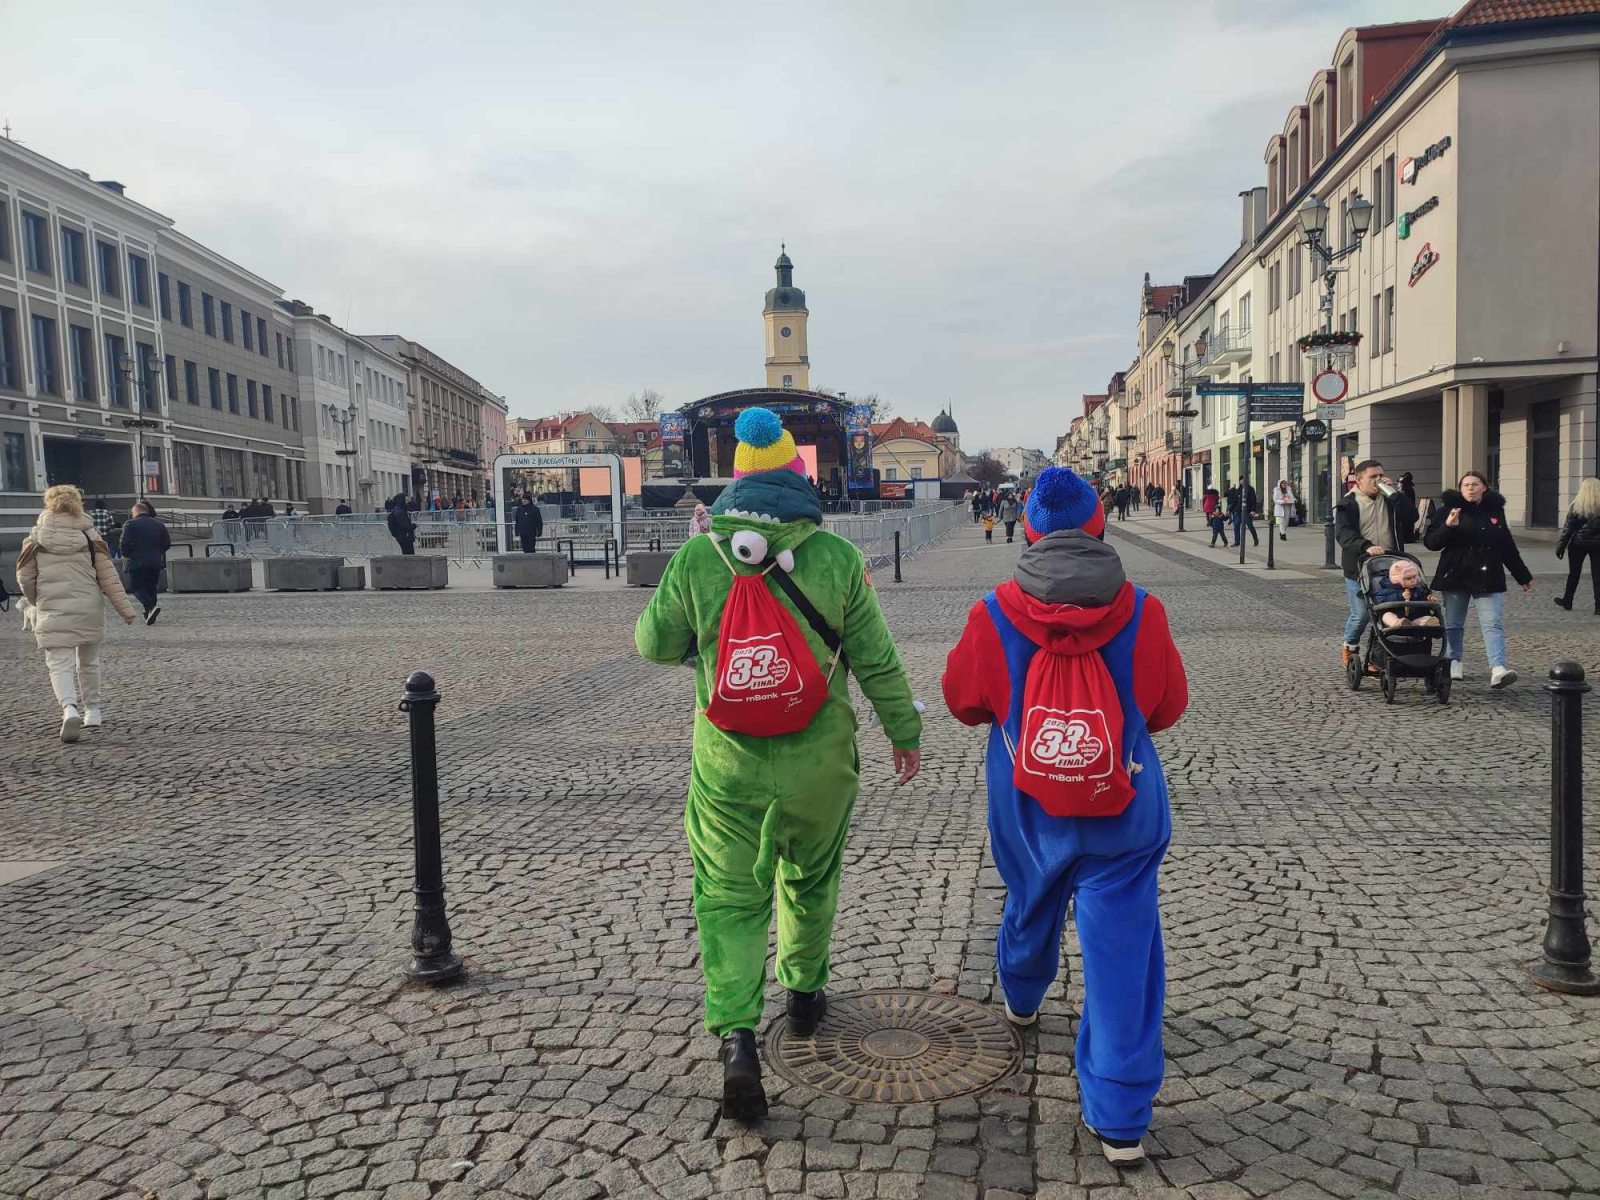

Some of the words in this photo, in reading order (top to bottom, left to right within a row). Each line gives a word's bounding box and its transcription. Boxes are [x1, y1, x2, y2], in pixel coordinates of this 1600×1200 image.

[730, 648, 775, 686] 33
[746, 692, 778, 702] mBank
[1035, 725, 1085, 758] 33
[1048, 773, 1085, 782] mBank
